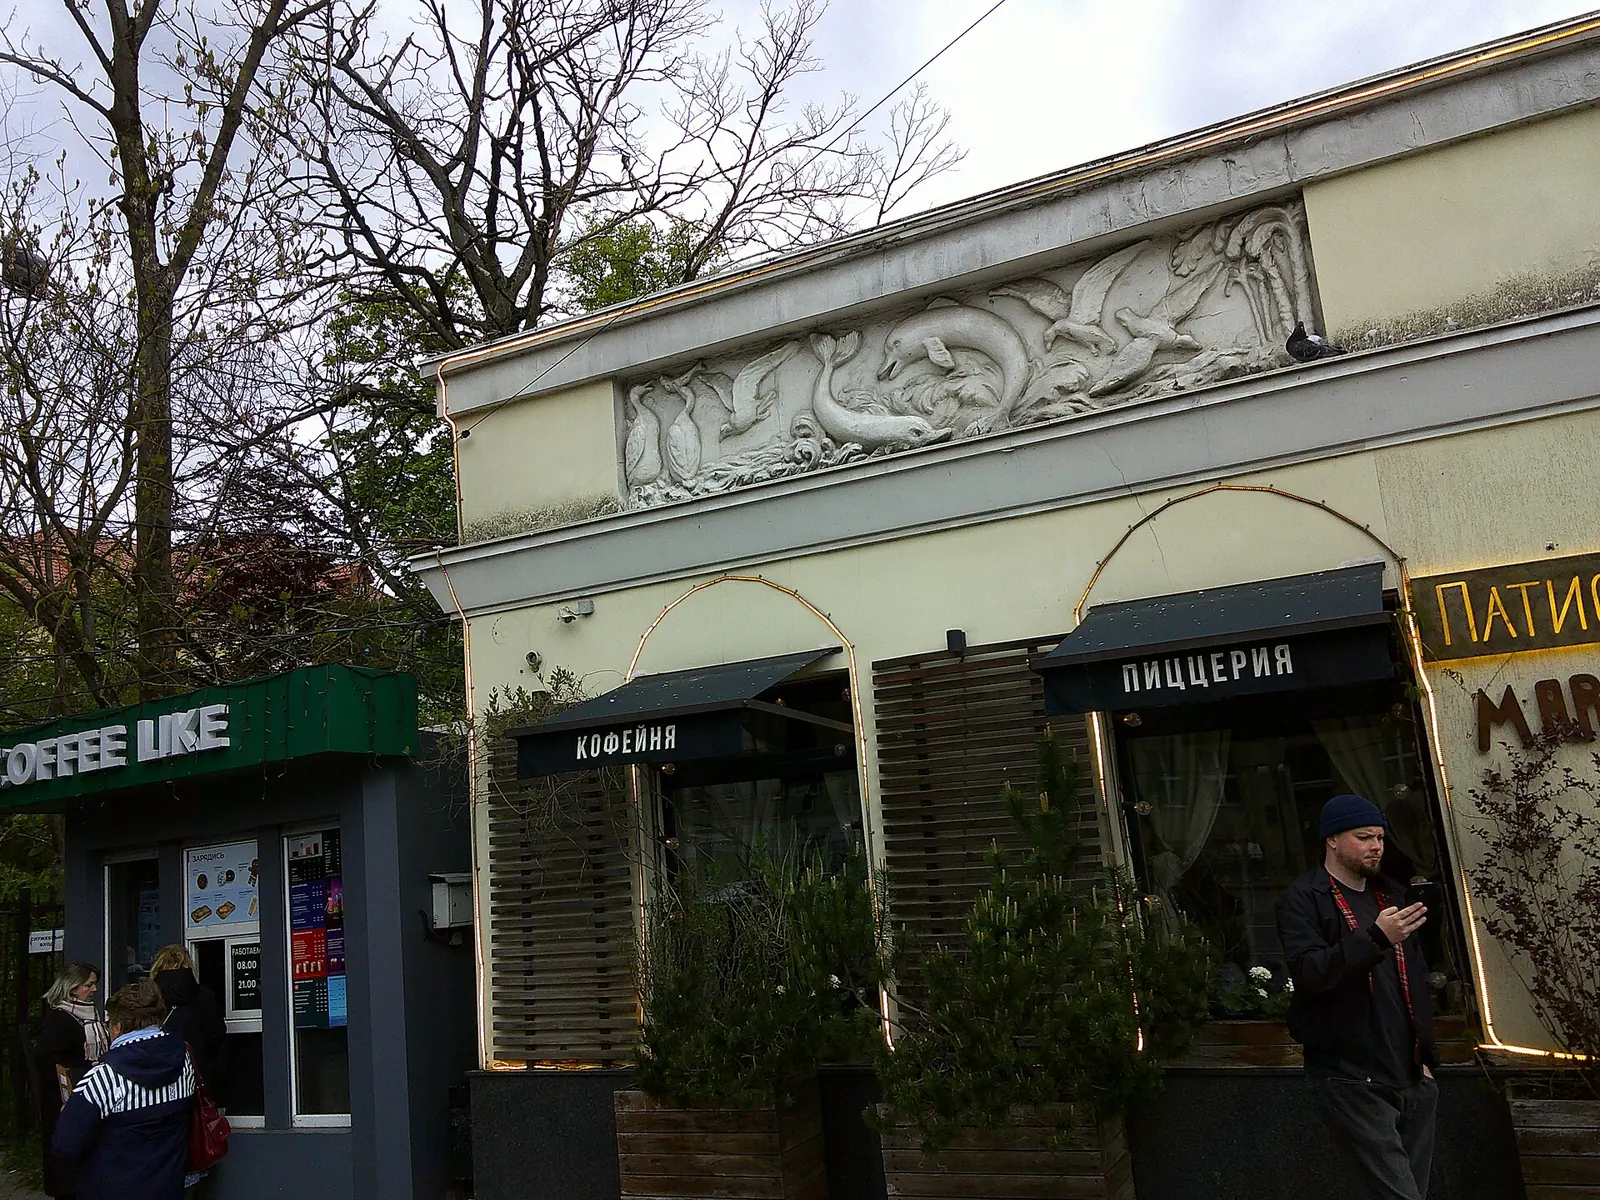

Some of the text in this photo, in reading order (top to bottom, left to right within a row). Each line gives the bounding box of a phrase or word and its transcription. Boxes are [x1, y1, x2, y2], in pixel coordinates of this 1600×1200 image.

[1122, 644, 1294, 693] ПИЦЦЕРИЯ
[137, 703, 230, 762] LIKE
[576, 724, 676, 760] КОФЕЙНЯ
[192, 852, 225, 863] ЗАРЯДИСЬ
[236, 960, 257, 970] 08.00
[238, 979, 256, 989] 21.00
